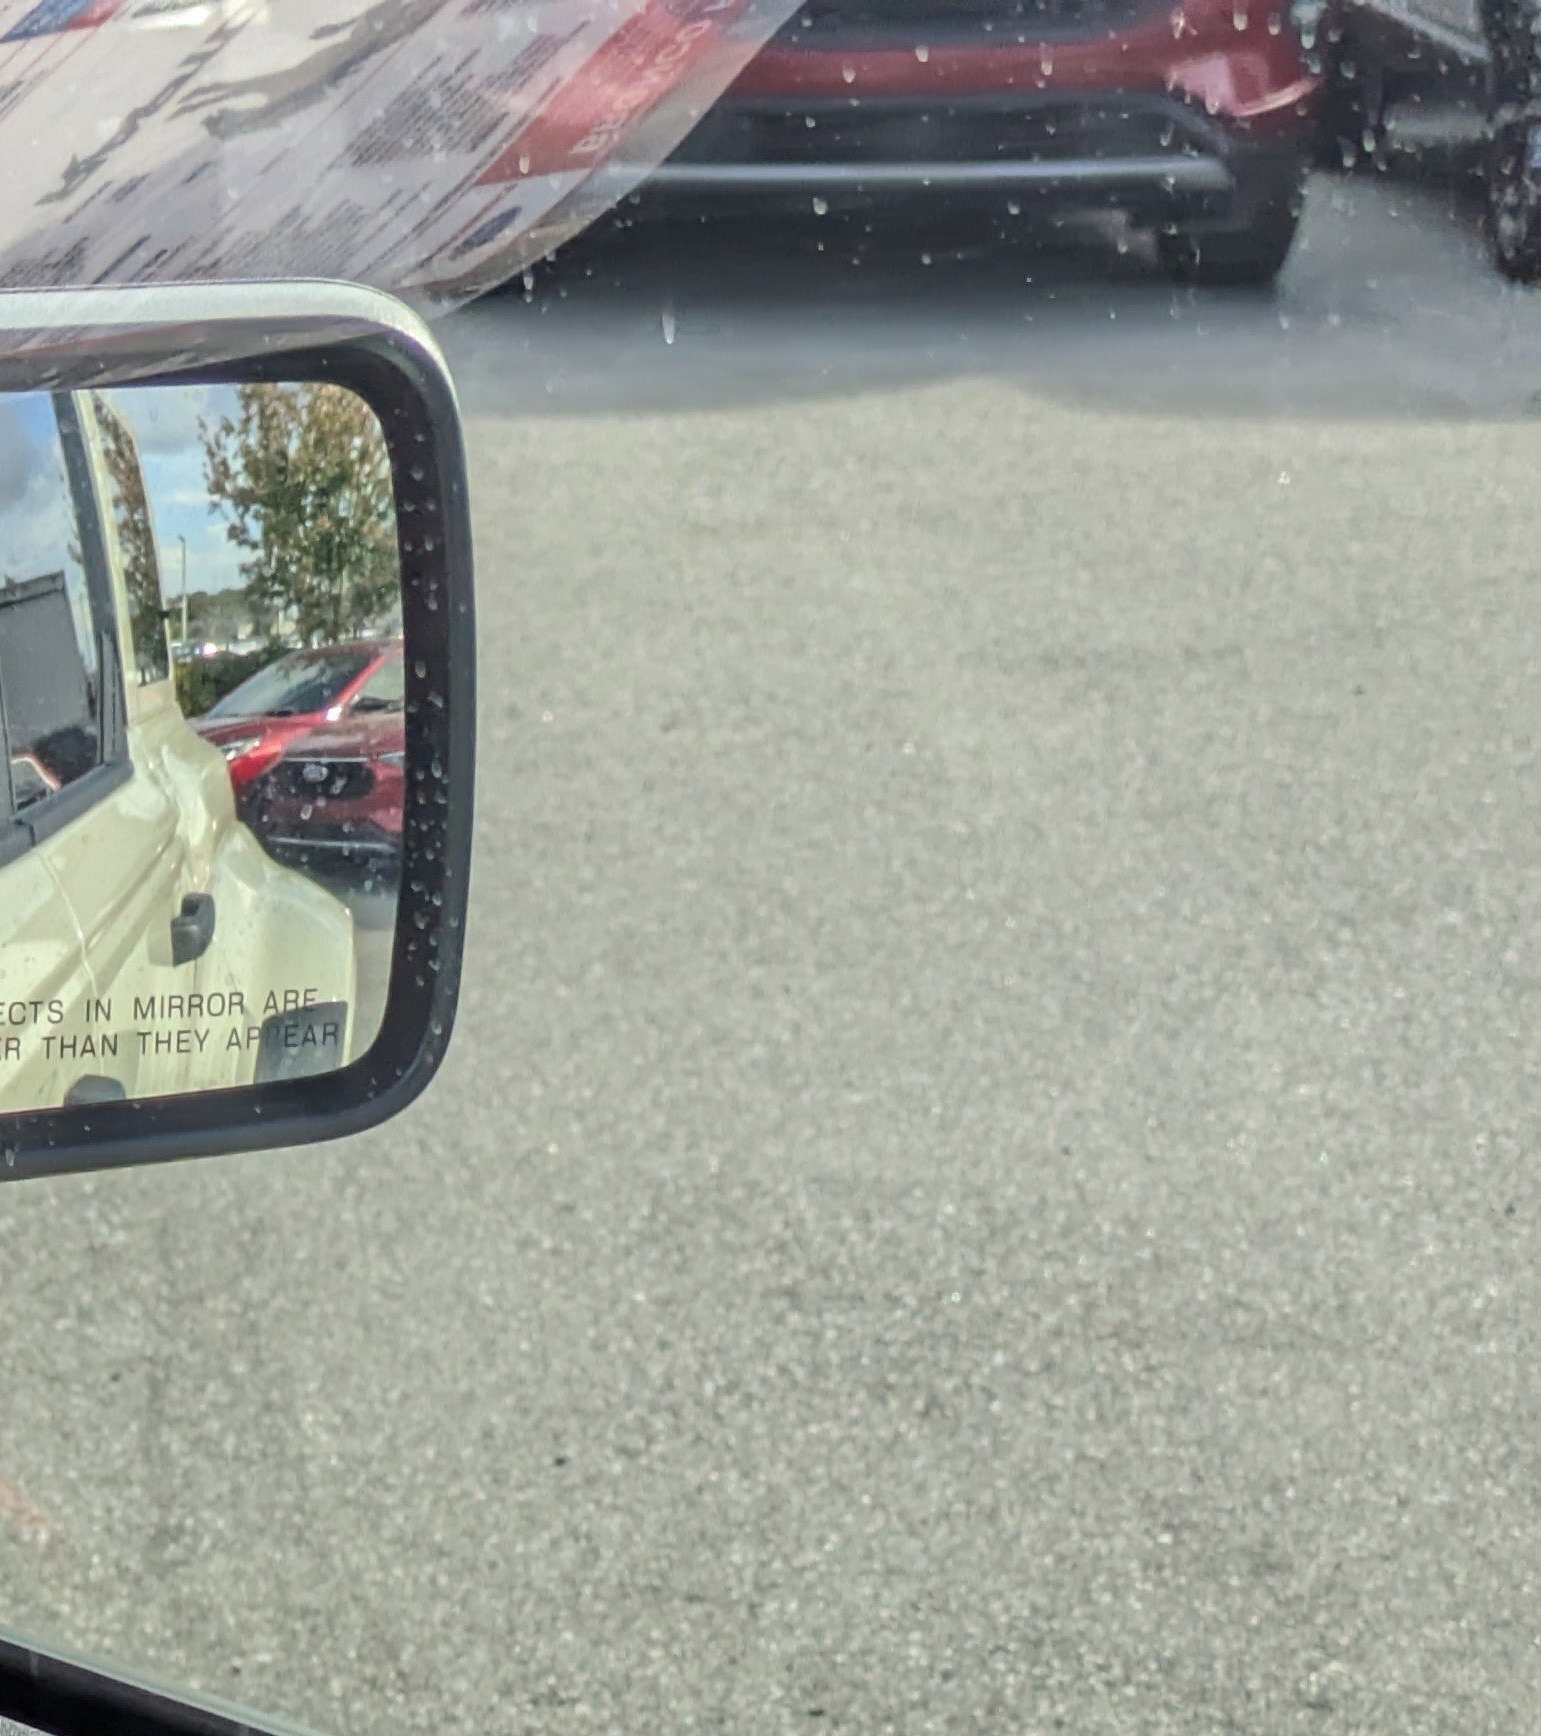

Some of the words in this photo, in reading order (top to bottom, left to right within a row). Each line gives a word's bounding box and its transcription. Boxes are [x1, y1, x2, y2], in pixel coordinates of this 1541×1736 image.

[85, 997, 113, 1023] IN
[132, 991, 245, 1021] MIRROR
[262, 988, 319, 1015] ARE
[42, 1031, 119, 1060] THAN
[136, 1028, 211, 1056] THEY
